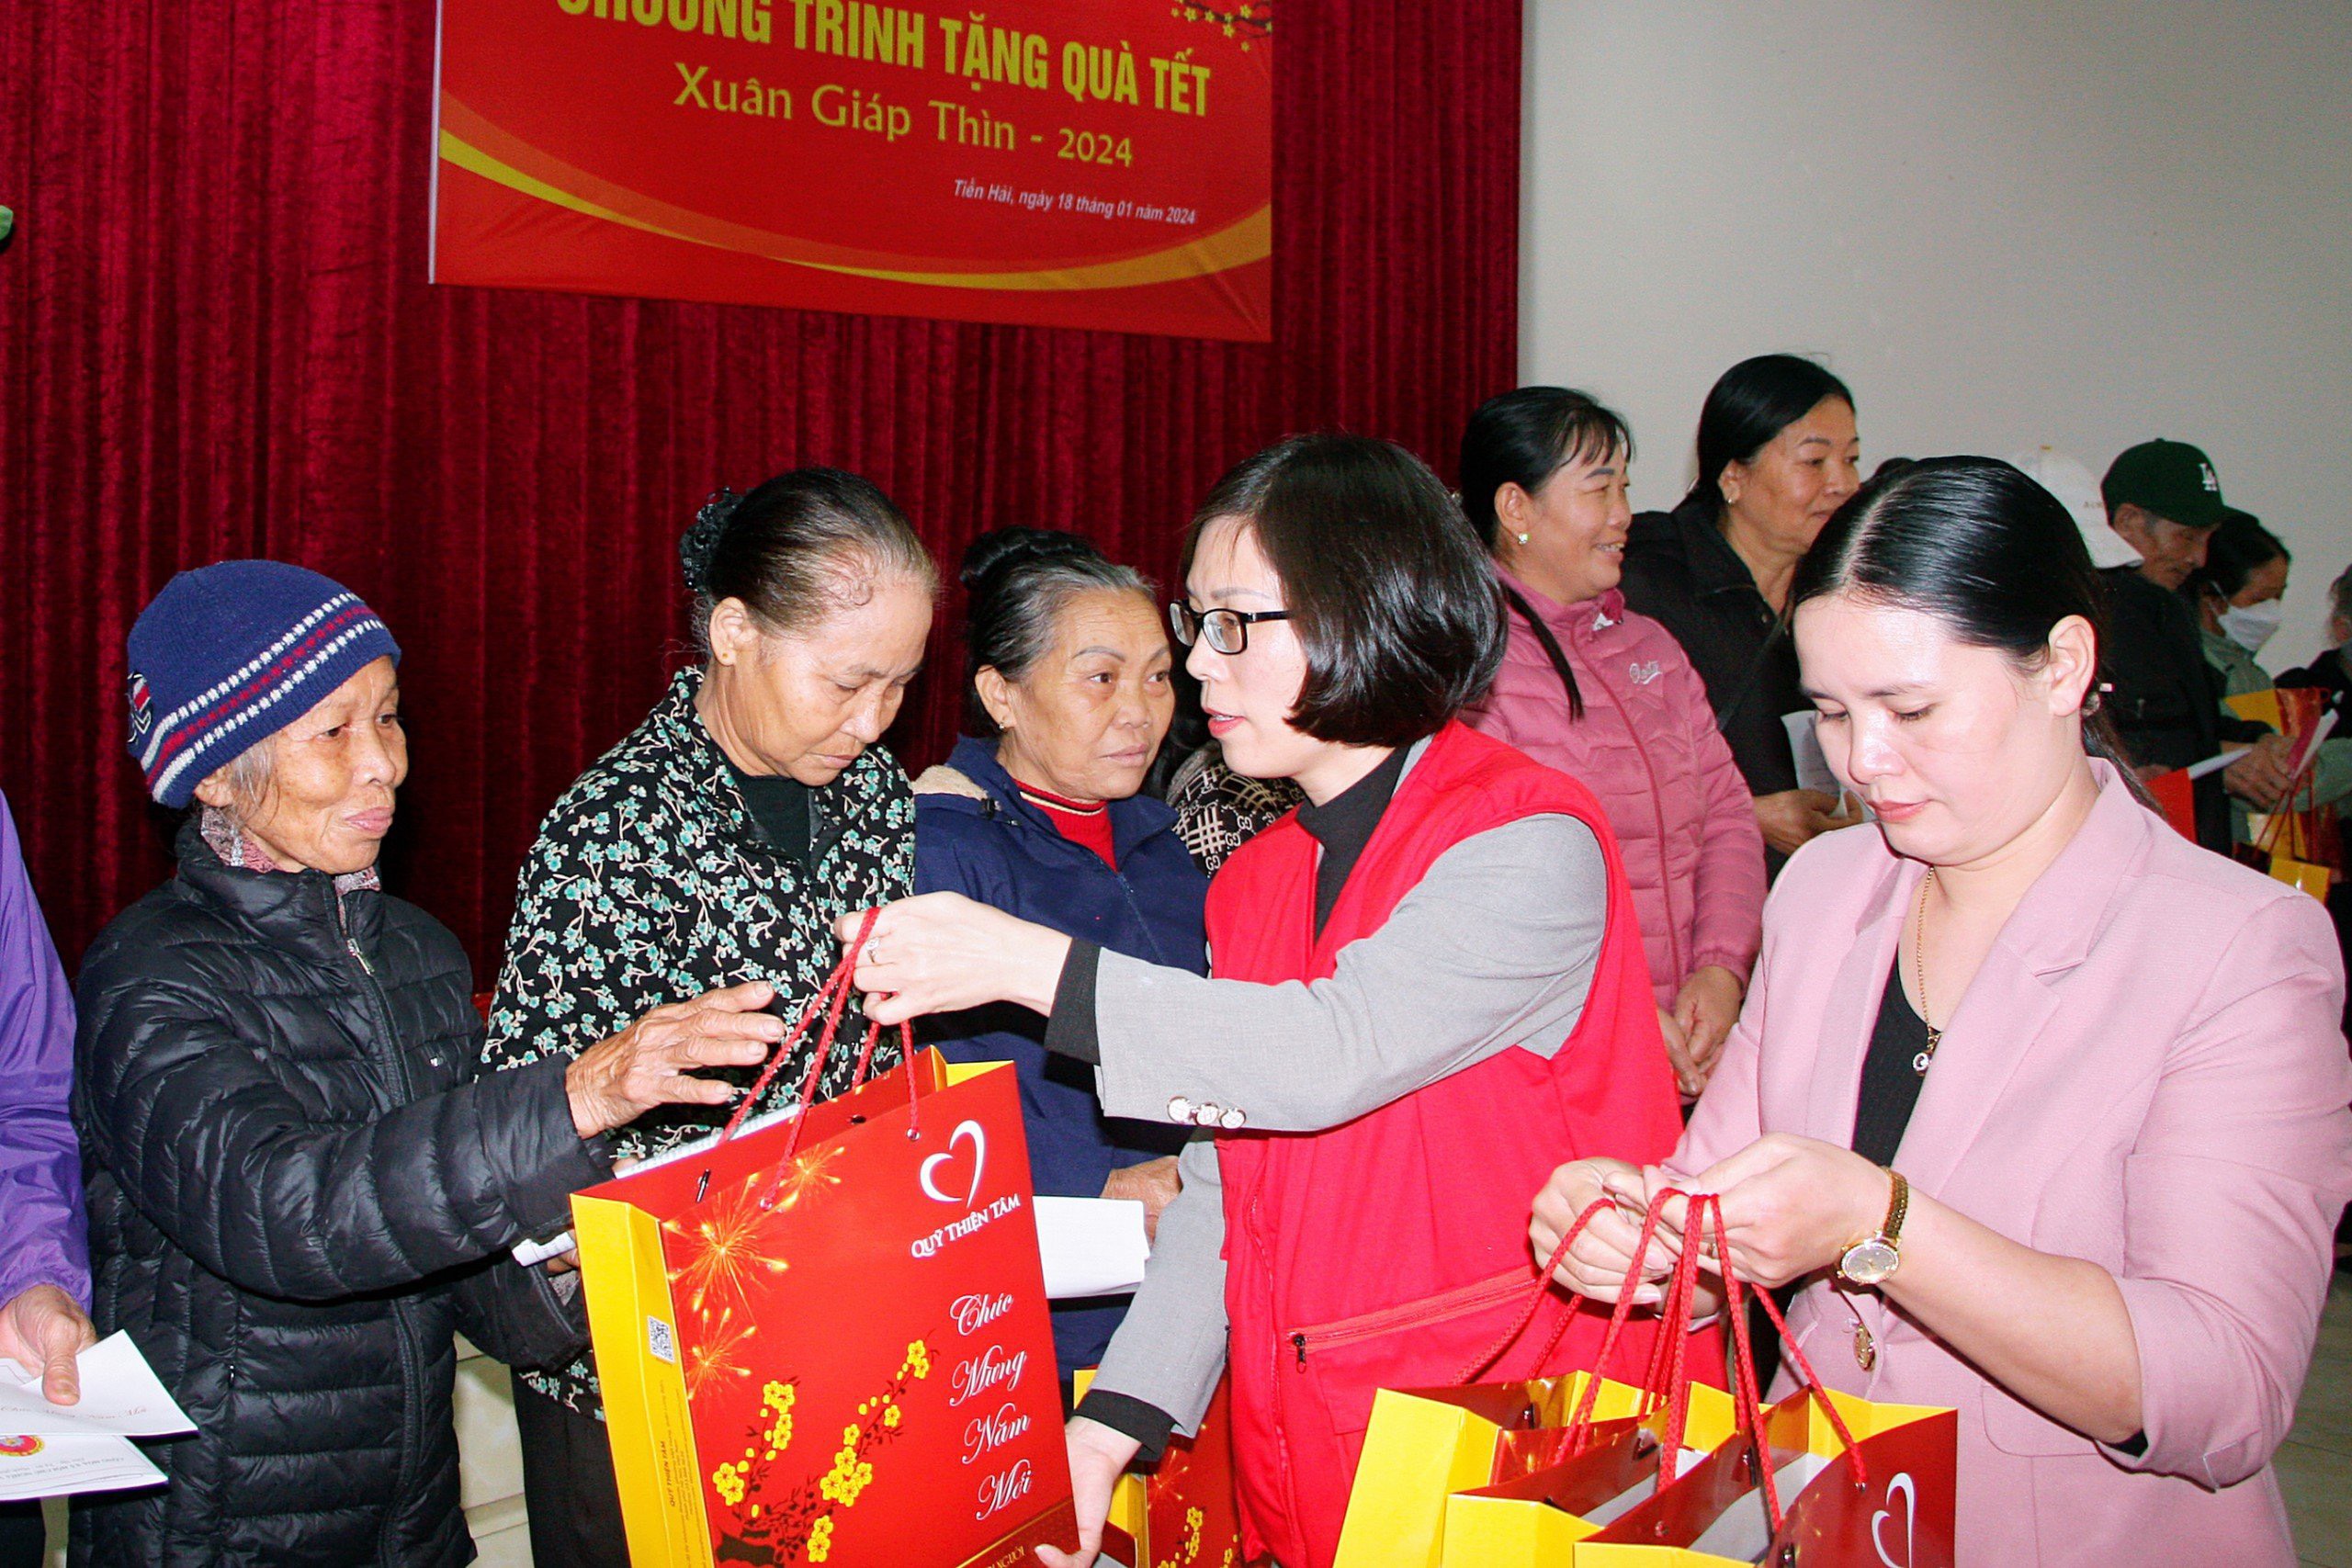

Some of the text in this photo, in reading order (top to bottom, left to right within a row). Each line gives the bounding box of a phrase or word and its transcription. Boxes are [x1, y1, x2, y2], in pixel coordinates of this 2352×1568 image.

[939, 10, 1047, 91] TẶNG
[1062, 40, 1139, 105] QUÀ
[1149, 48, 1210, 117] TẾT
[673, 62, 1133, 168] Xuân Giáp Thìn - 2024
[955, 177, 984, 199] Tiền
[1018, 189, 1054, 212] ngày
[1058, 192, 1073, 209] 18
[1076, 196, 1114, 219] tháng
[1116, 200, 1133, 218] 01
[1136, 204, 1163, 220] năm
[1166, 206, 1196, 224] 2024
[911, 1193, 1021, 1258] QUỸ THIỆN TÂM
[949, 1293, 1012, 1336] Chúc
[949, 1344, 1027, 1406] Mừng
[962, 1402, 1031, 1464] Năm
[976, 1459, 1033, 1520] Mới
